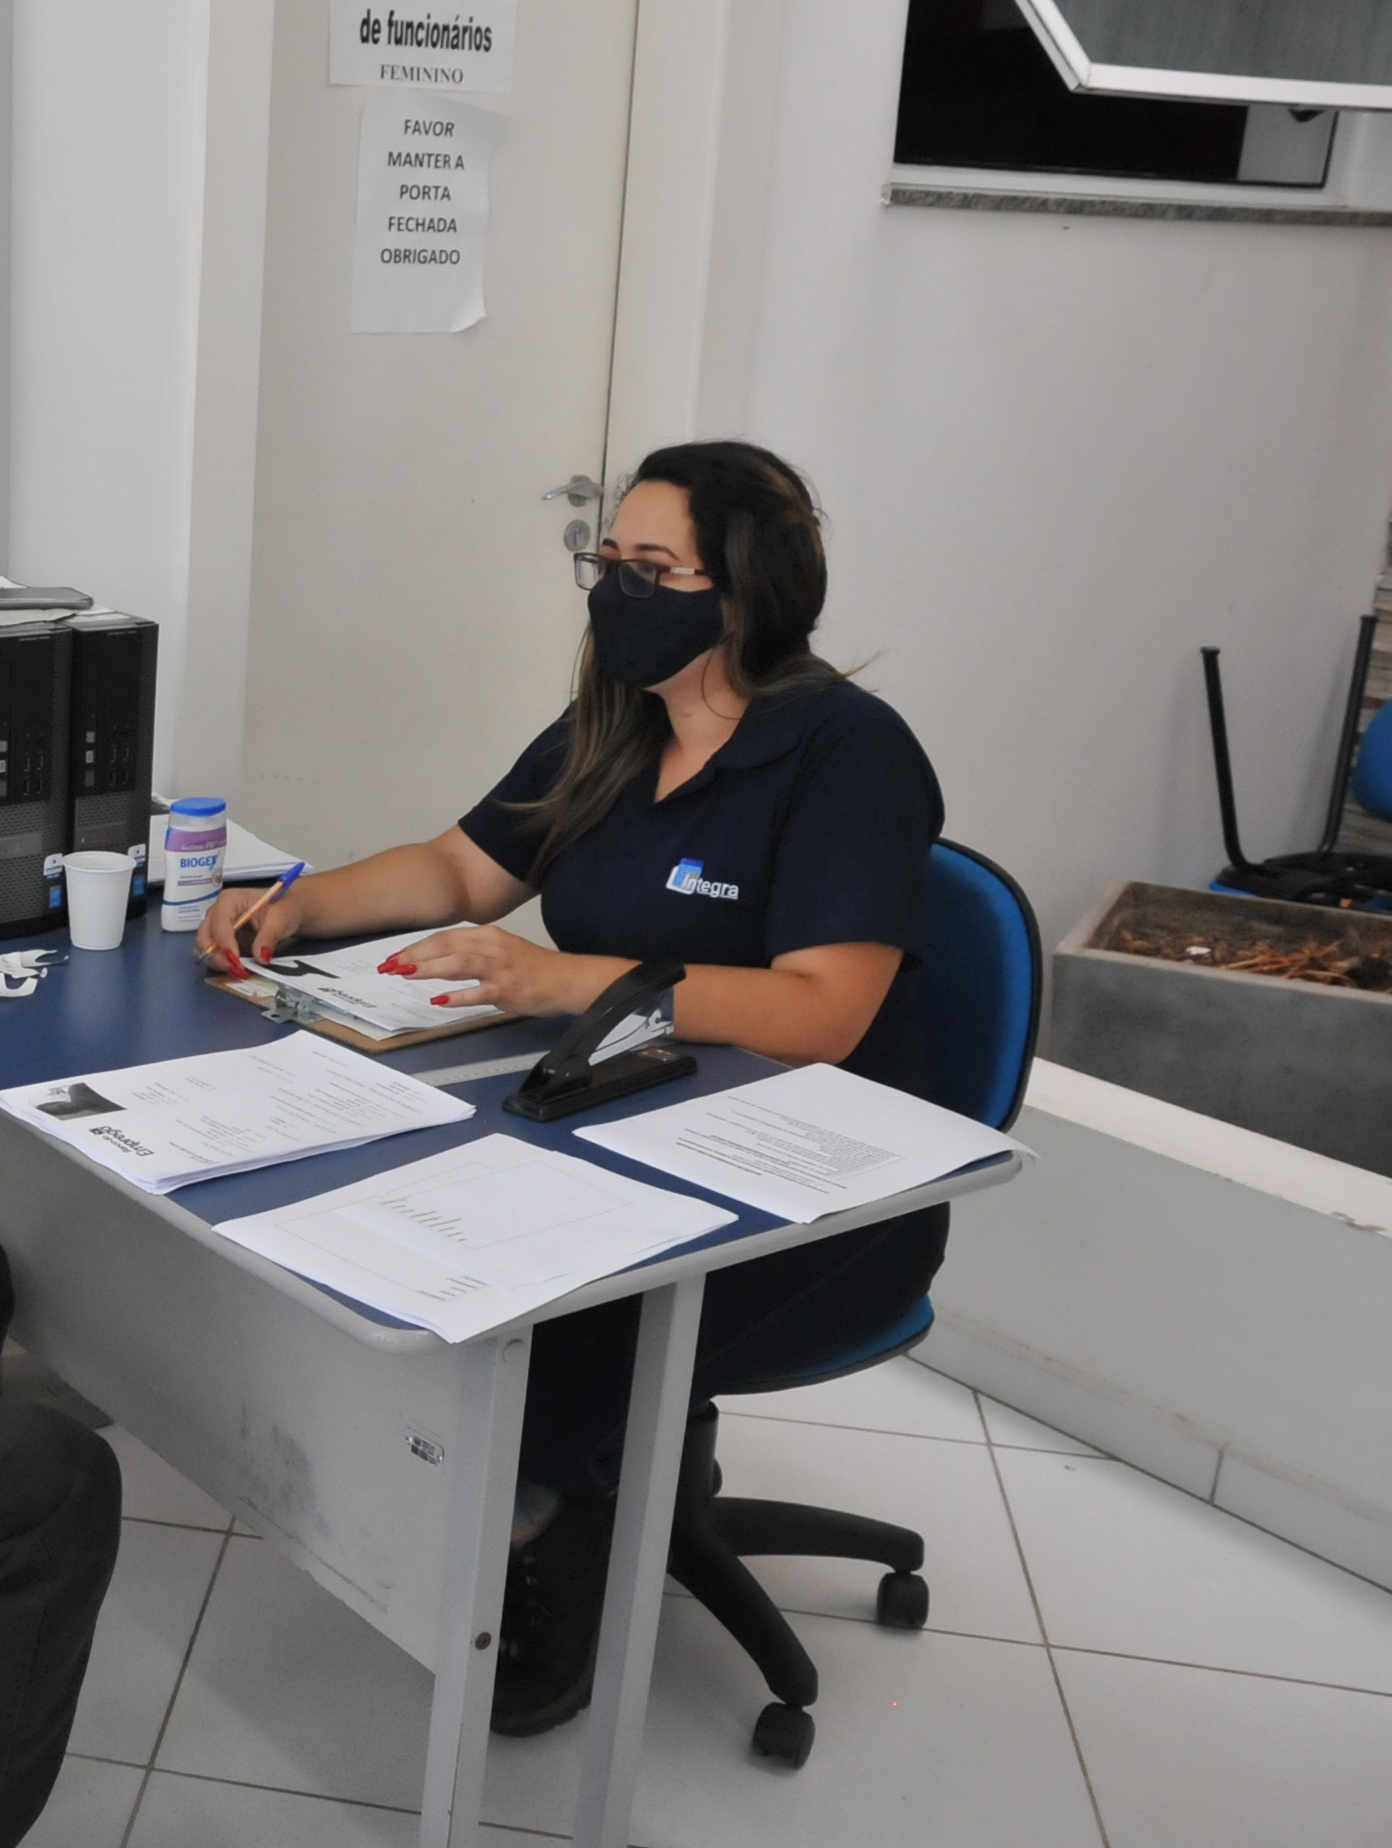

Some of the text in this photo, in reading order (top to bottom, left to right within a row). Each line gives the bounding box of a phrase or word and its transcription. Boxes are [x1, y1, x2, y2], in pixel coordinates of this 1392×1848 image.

[359, 8, 493, 52] de funcionários
[379, 64, 464, 84] FEMININO
[403, 119, 455, 138] FAVOR
[387, 151, 465, 170] MANTER A
[399, 184, 451, 201] PORTA
[388, 216, 458, 233] FECHADA
[380, 248, 461, 265] OBRIGADO
